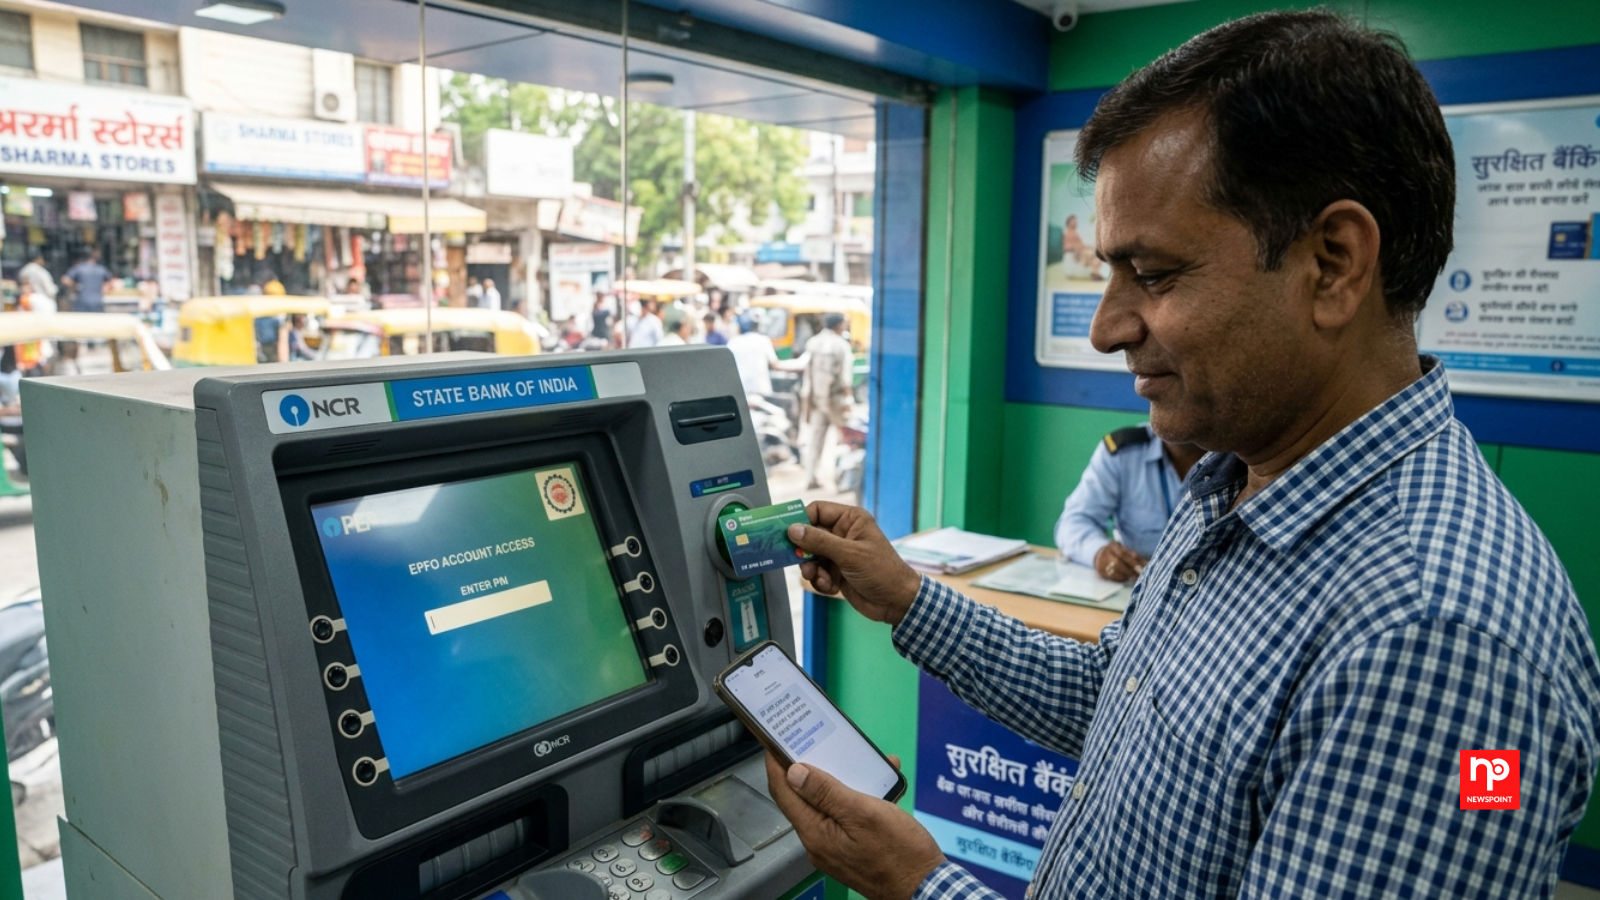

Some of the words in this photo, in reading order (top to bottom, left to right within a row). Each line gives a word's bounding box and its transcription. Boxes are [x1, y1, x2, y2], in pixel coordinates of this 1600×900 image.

[1, 147, 93, 168] SHARMA
[100, 154, 176, 174] STORES
[1471, 148, 1546, 180] सुरक्षित
[412, 386, 465, 407] STATE
[467, 382, 513, 401] BANK
[515, 380, 536, 396] OF
[538, 376, 579, 394] INDIA
[311, 397, 362, 418] NCR
[408, 559, 440, 575] EPFO
[441, 546, 494, 568] ACCOUNT
[494, 536, 536, 555] ACCESS
[460, 579, 493, 596] ENTER
[945, 743, 1027, 786] सुरक्षित
[615, 863, 626, 873] 6
